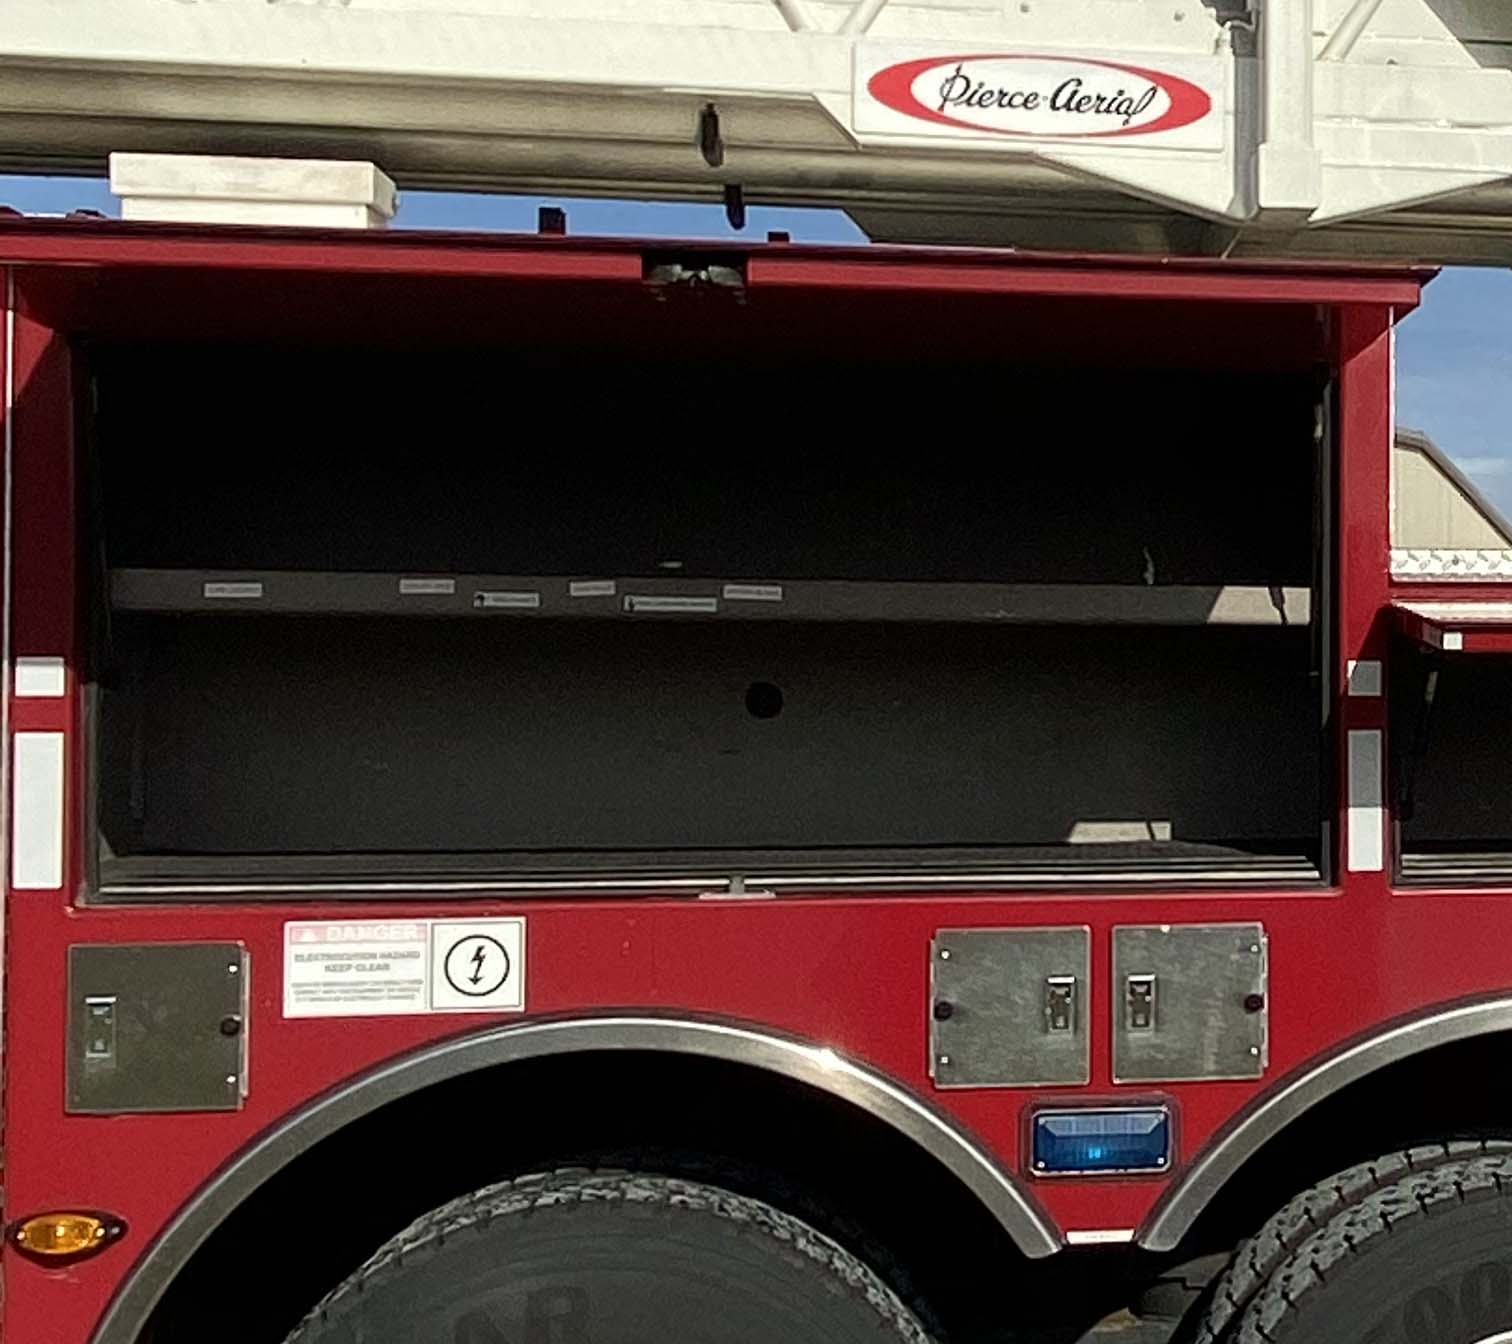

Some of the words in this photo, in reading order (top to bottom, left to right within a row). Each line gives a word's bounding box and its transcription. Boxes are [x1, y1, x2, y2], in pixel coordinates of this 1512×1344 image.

[937, 63, 1040, 112] Pierce
[1049, 77, 1158, 126] Aerial
[325, 924, 418, 942] DANGER
[324, 963, 353, 973] KEEP
[354, 962, 391, 972] CLEAR
